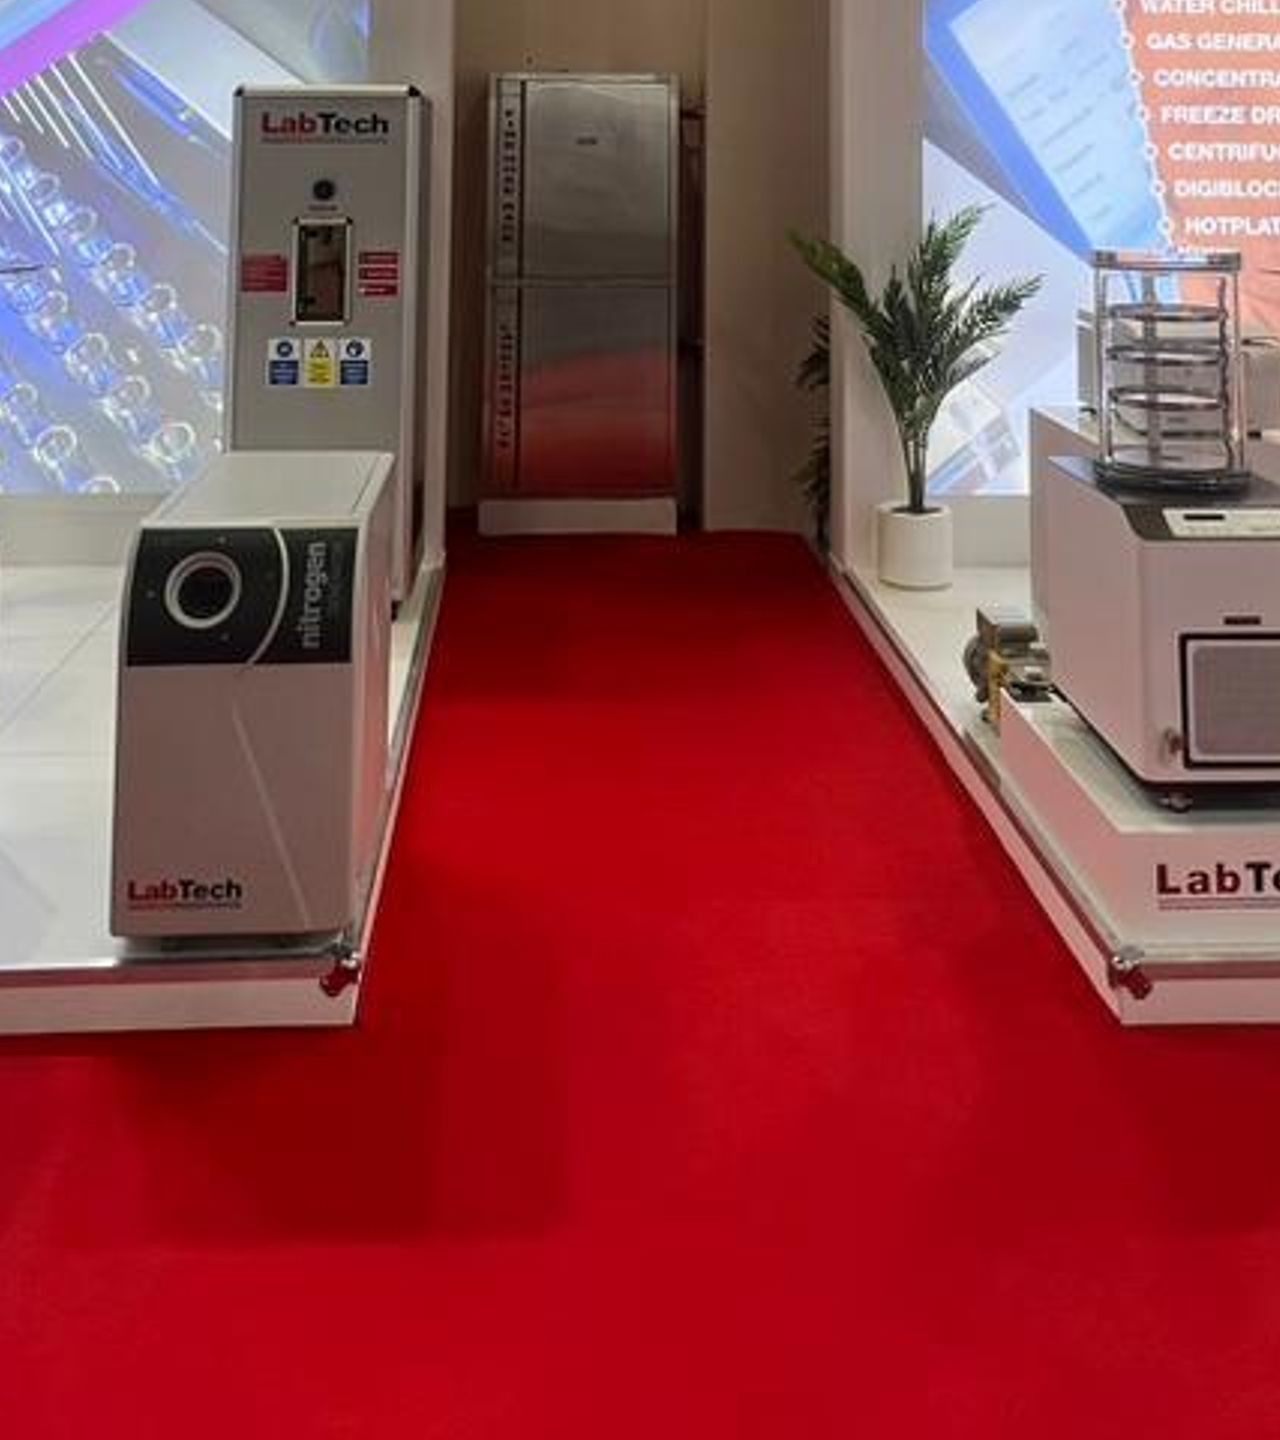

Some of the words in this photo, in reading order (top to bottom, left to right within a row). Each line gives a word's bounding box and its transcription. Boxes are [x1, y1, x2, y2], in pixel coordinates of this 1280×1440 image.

[1146, 32, 1192, 51] GAS
[260, 112, 390, 135] LabTech
[1161, 106, 1245, 125] FREEZE
[294, 540, 327, 650] nitrogen
[126, 879, 243, 902] LabTech
